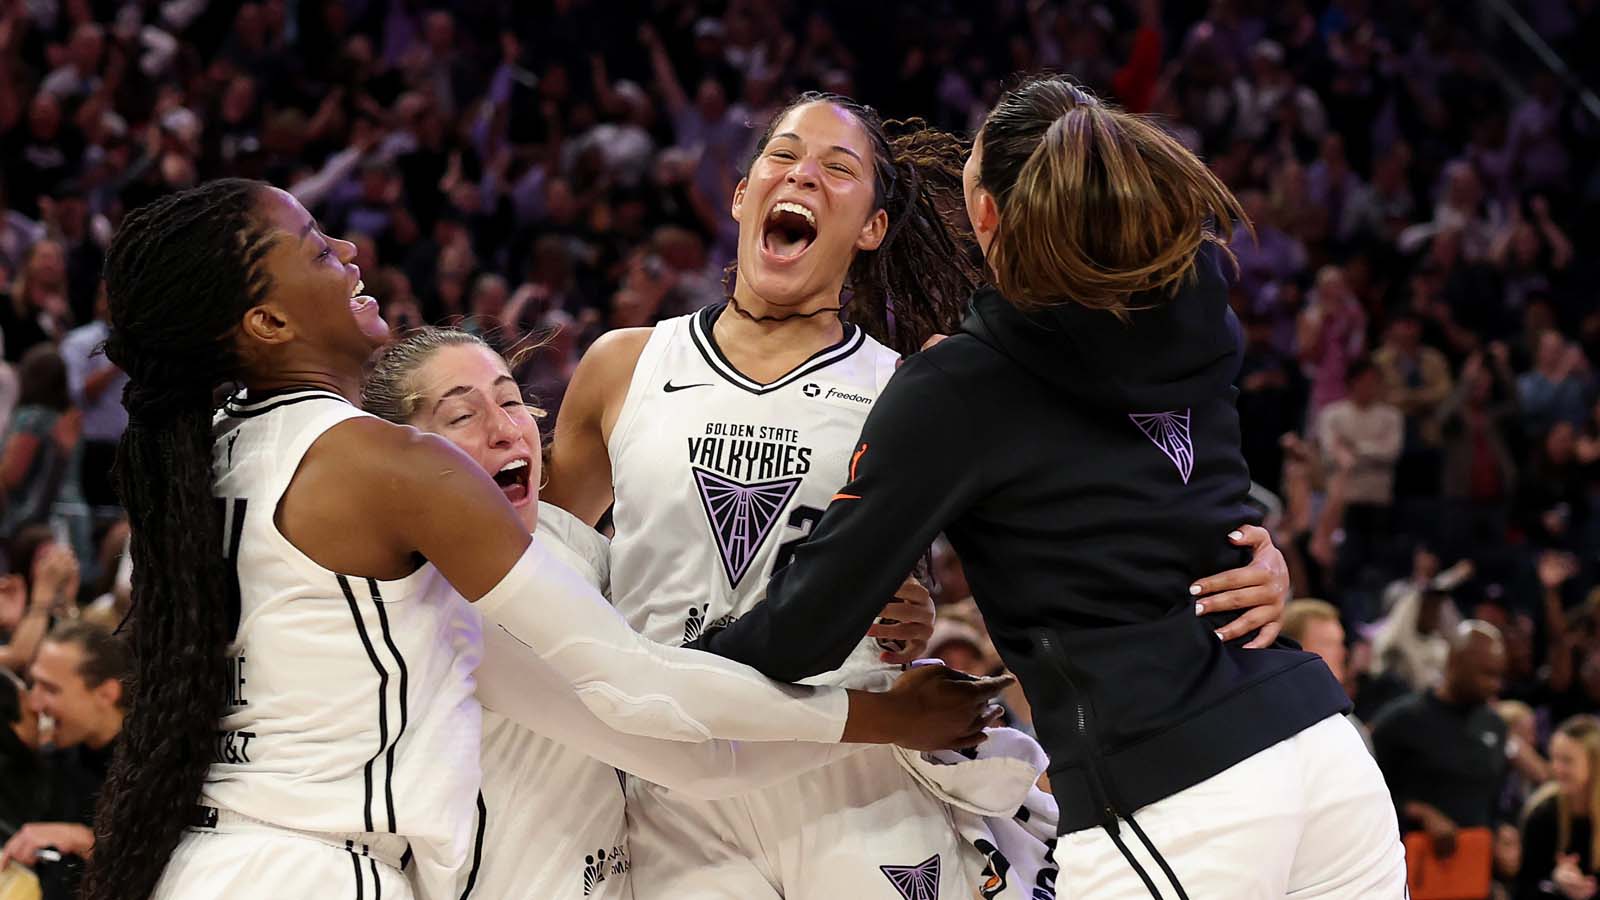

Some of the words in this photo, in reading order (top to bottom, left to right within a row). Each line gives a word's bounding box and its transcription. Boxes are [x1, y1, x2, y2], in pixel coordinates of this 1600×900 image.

[825, 388, 873, 405] freedom
[705, 422, 755, 438] GOLDEN
[759, 426, 799, 443] STATE
[688, 437, 812, 481] VALKYRIES
